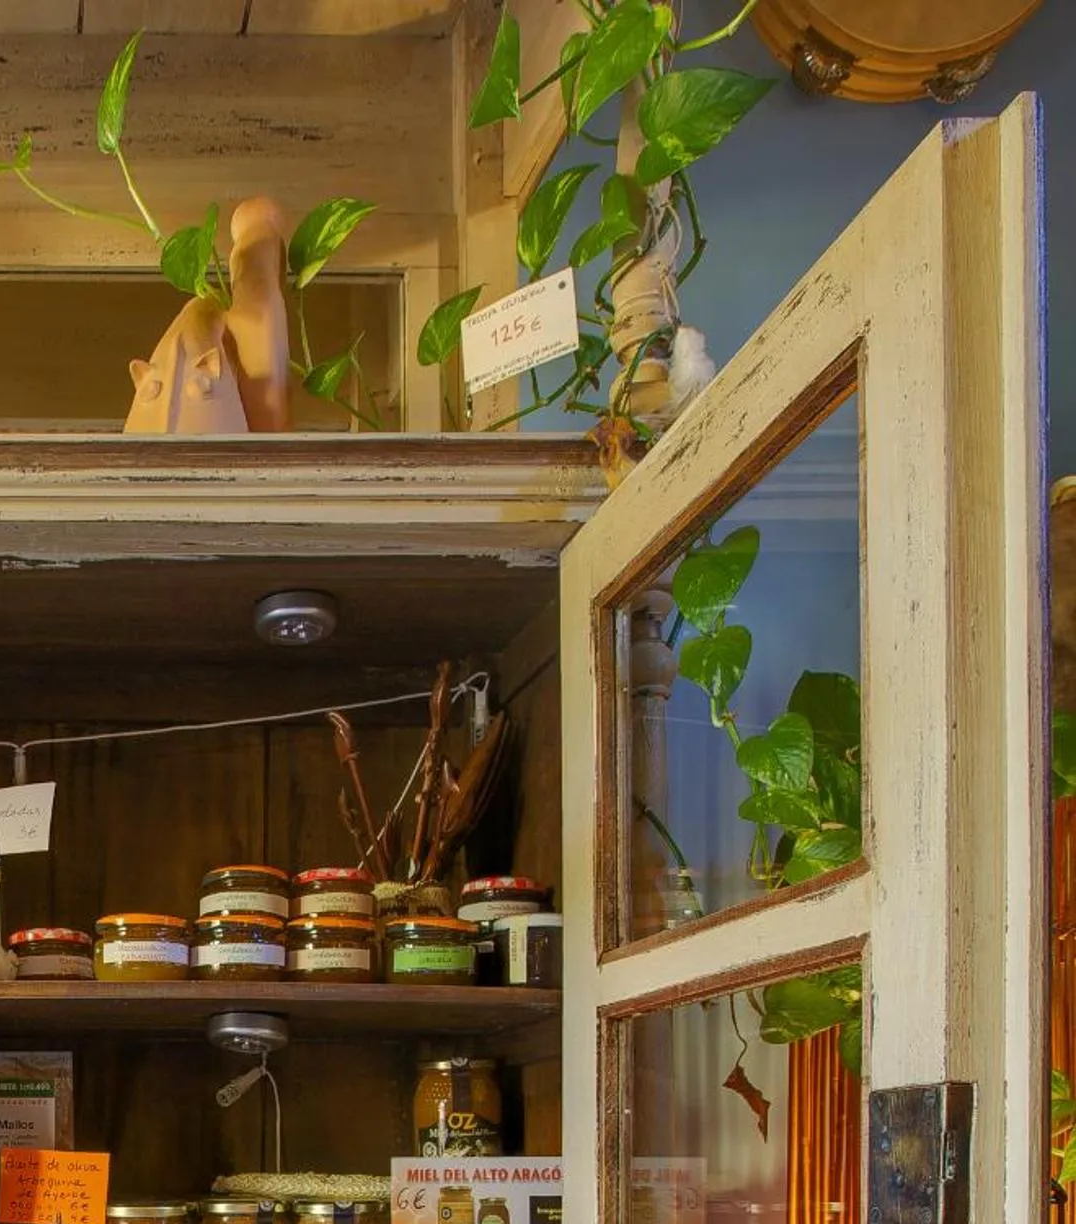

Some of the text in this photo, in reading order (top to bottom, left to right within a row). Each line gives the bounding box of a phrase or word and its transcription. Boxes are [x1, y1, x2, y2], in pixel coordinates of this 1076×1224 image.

[447, 1112, 477, 1129] OZ
[406, 1165, 562, 1183] MIEL DEL ALTO ARAGÓ
[397, 1186, 426, 1210] 6€
